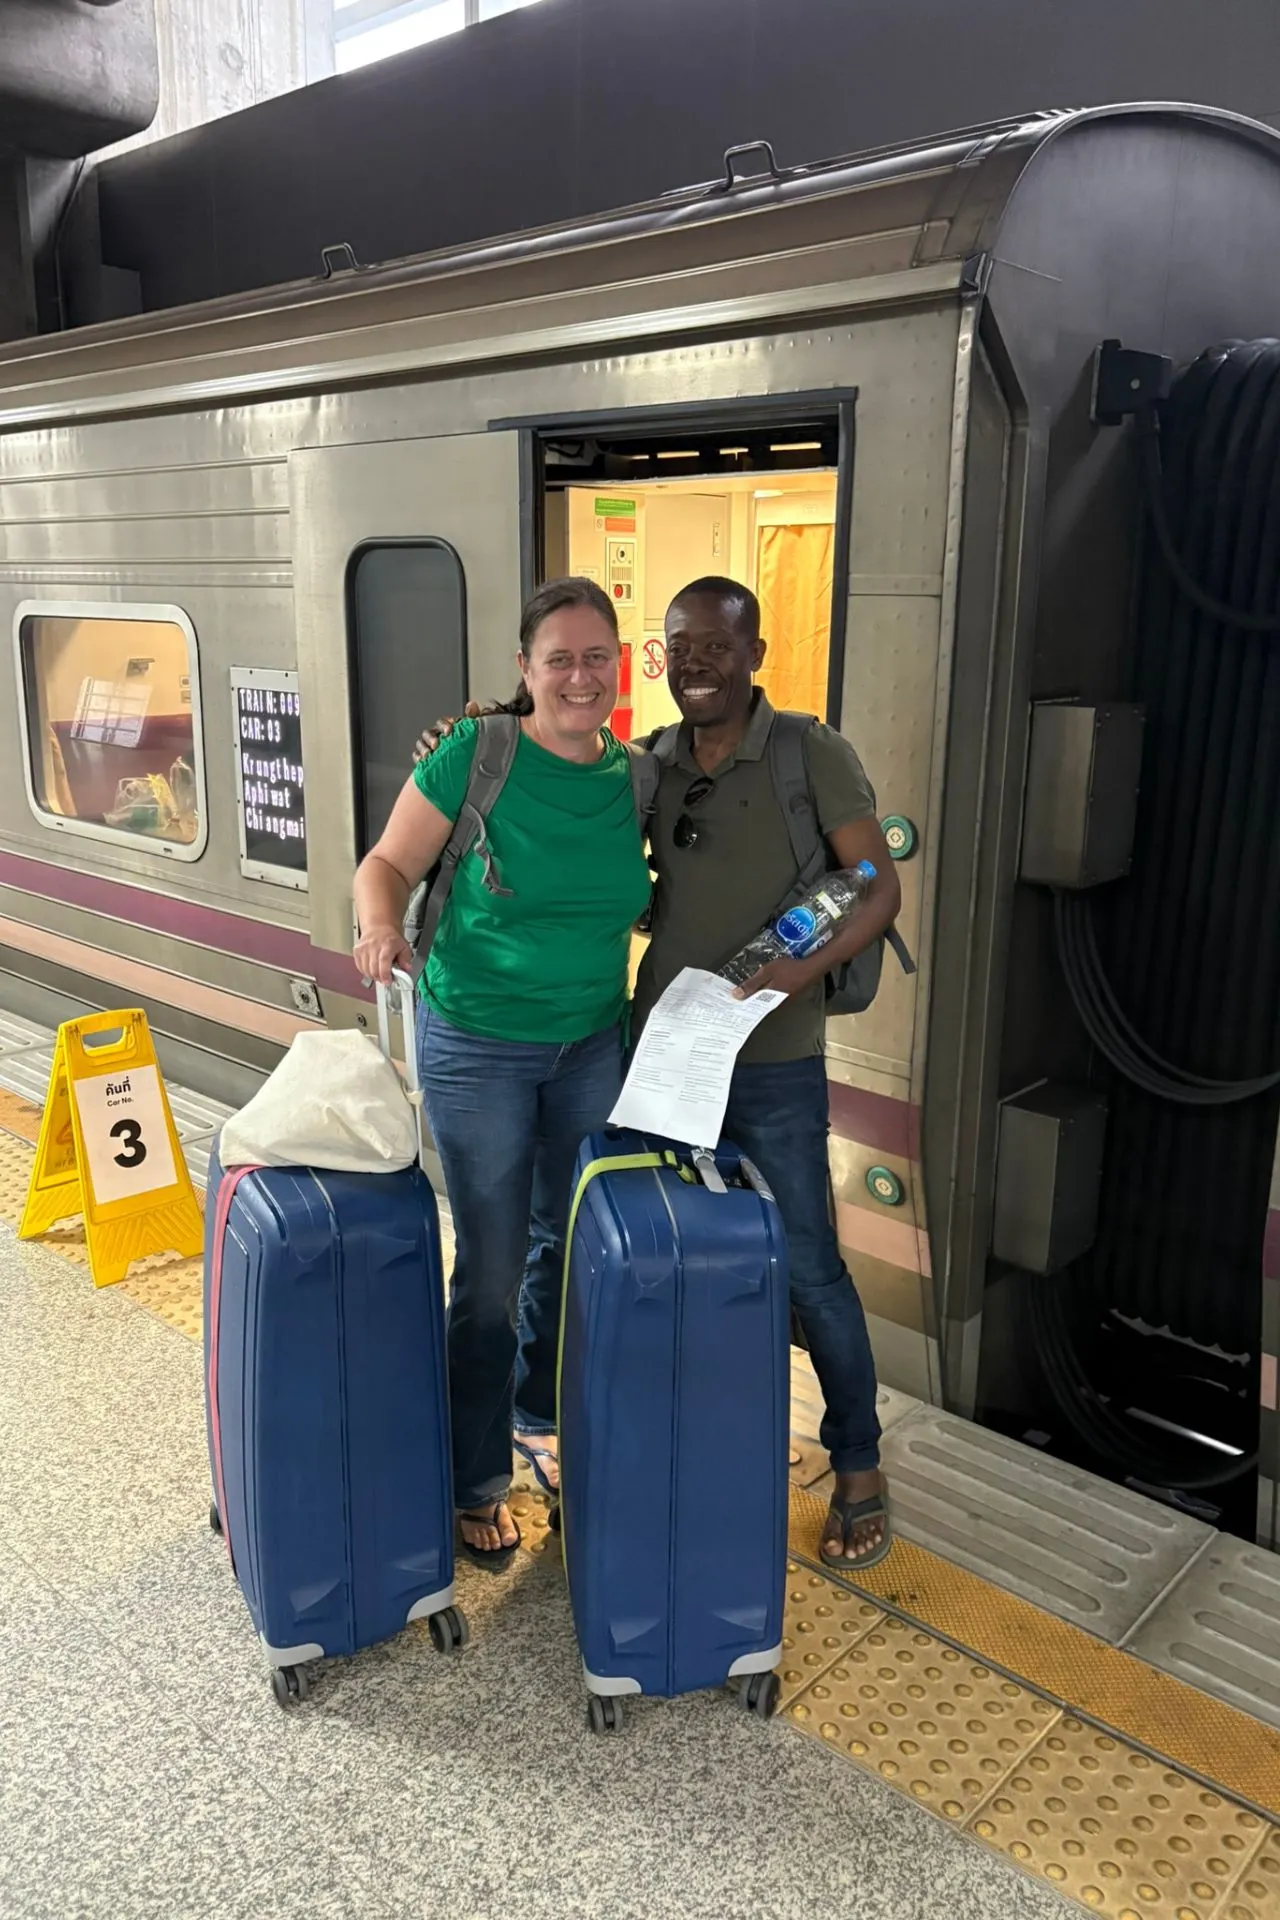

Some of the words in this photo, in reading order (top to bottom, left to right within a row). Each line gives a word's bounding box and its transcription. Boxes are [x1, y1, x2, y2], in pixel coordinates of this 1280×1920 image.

[240, 688, 277, 714] TRAIN:
[280, 692, 299, 717] 009
[241, 716, 265, 741] CAR:
[267, 719, 281, 743] 03
[242, 752, 304, 788] Krungthep
[244, 780, 290, 808] Aphiwat
[245, 806, 304, 840] Chiangmai
[106, 1075, 131, 1096] คันที่
[106, 1099, 121, 1107] Car
[121, 1096, 134, 1104] No.
[109, 1118, 147, 1168] 3
